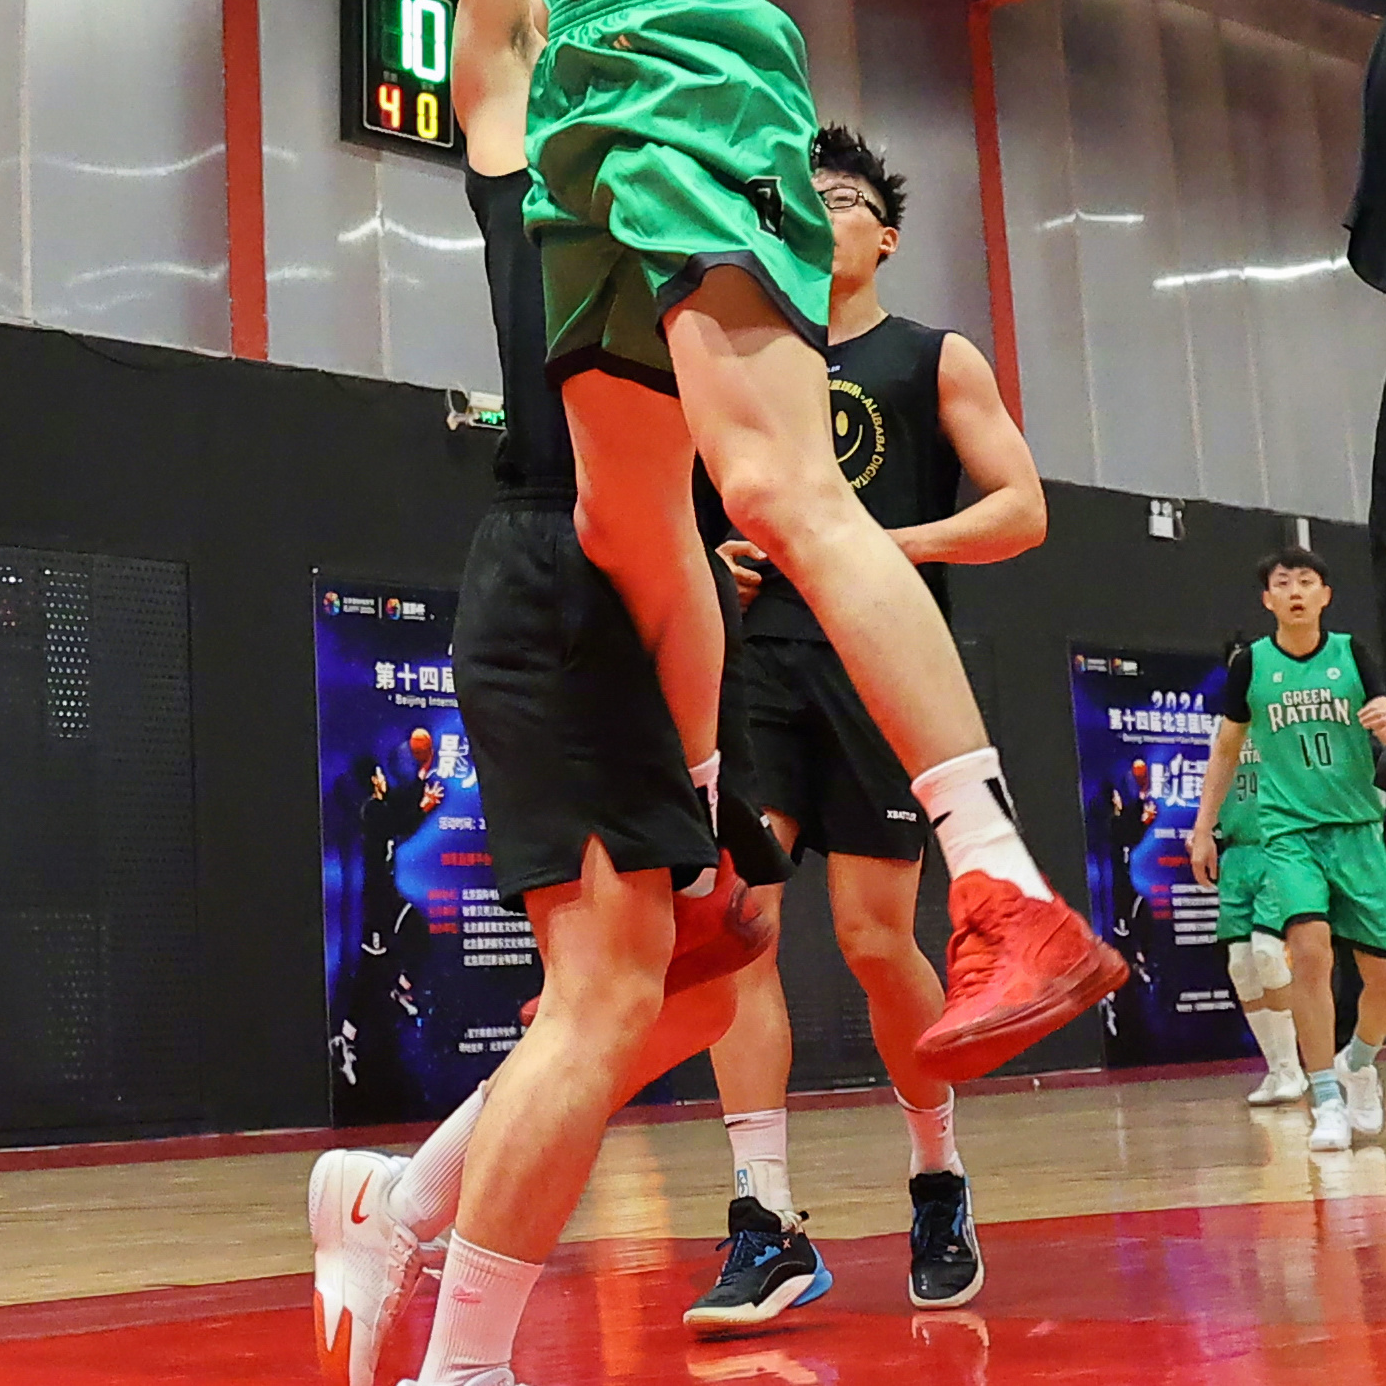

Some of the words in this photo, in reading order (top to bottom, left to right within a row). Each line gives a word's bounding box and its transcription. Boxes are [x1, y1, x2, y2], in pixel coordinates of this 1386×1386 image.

[379, 85, 400, 128] 4
[417, 92, 438, 139] 0
[862, 398, 885, 452] ALIBABA
[851, 454, 883, 489] DIGITA
[1282, 688, 1332, 706] GREEN
[1267, 698, 1351, 733] RATTAN
[1298, 731, 1332, 769] 10
